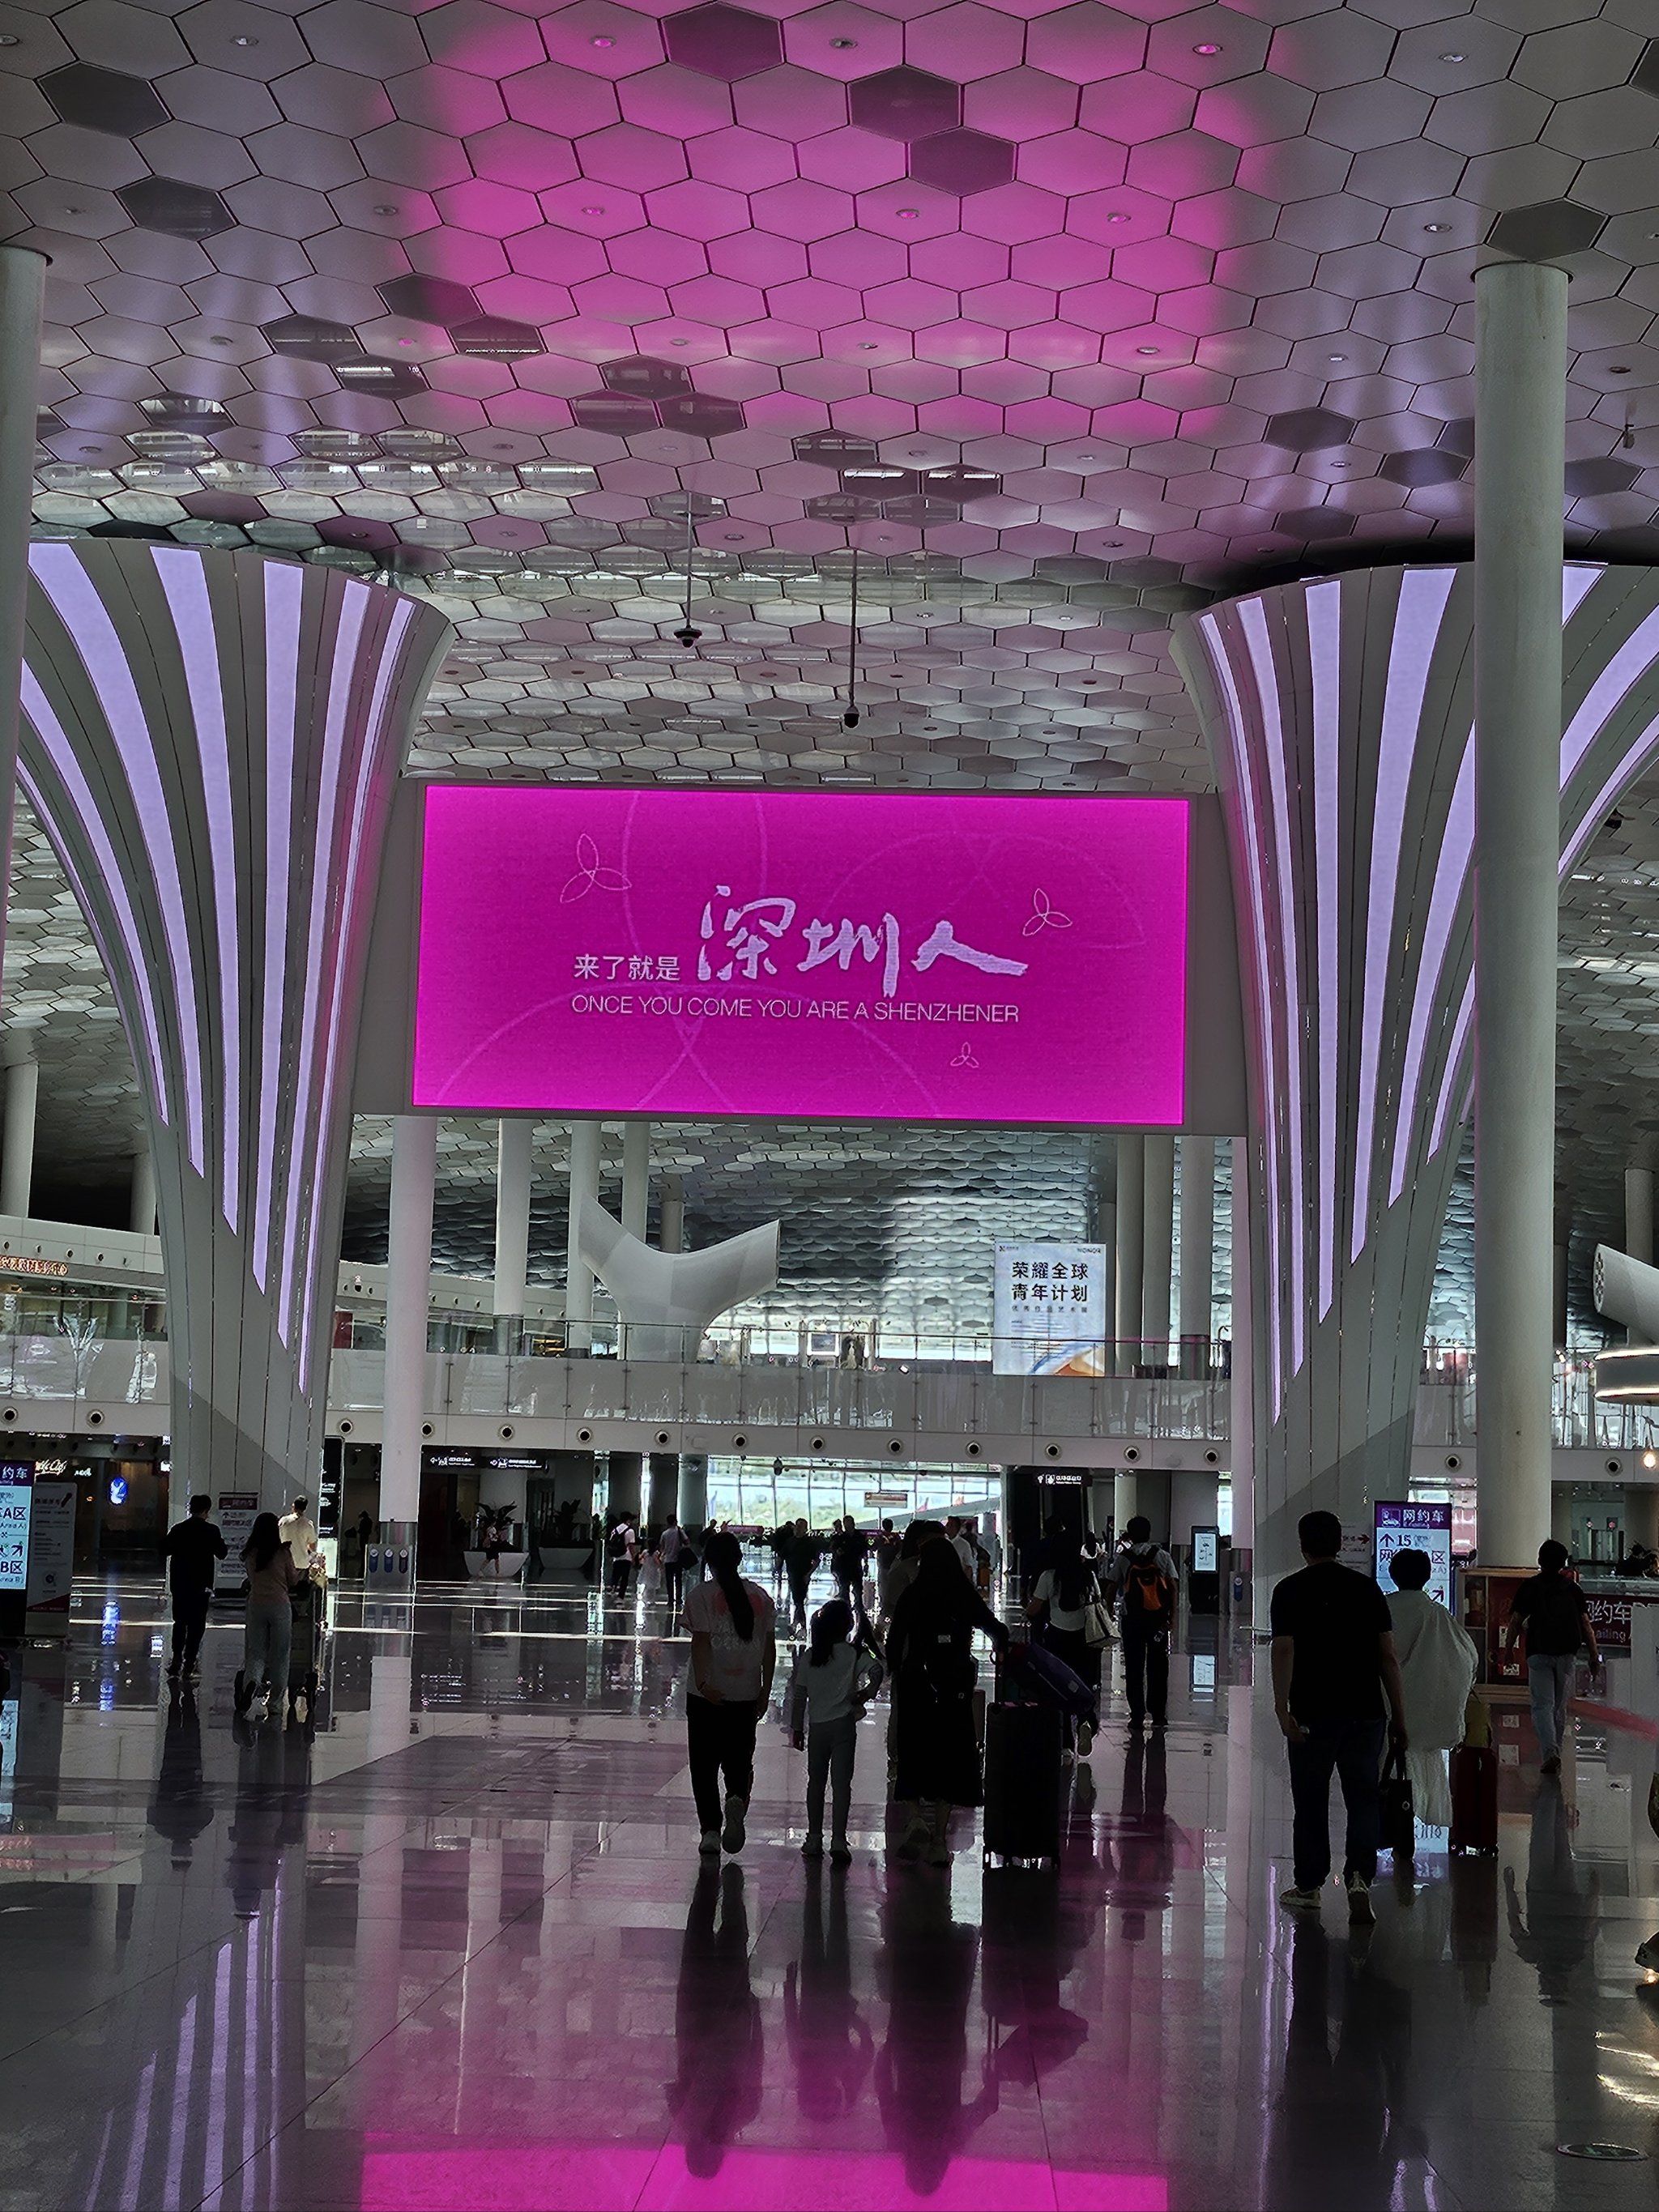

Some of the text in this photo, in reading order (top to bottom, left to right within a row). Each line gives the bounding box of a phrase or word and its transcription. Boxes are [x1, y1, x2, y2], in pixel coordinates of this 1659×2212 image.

[574, 884, 1029, 998] 来了就是 深圳人
[572, 995, 1020, 1022] ONCE YOU COME YOU ARE A SHENZHENER
[1012, 1261, 1089, 1280] 荣耀全球
[1012, 1283, 1088, 1302] 青年计划
[0, 1507, 27, 1520] A区
